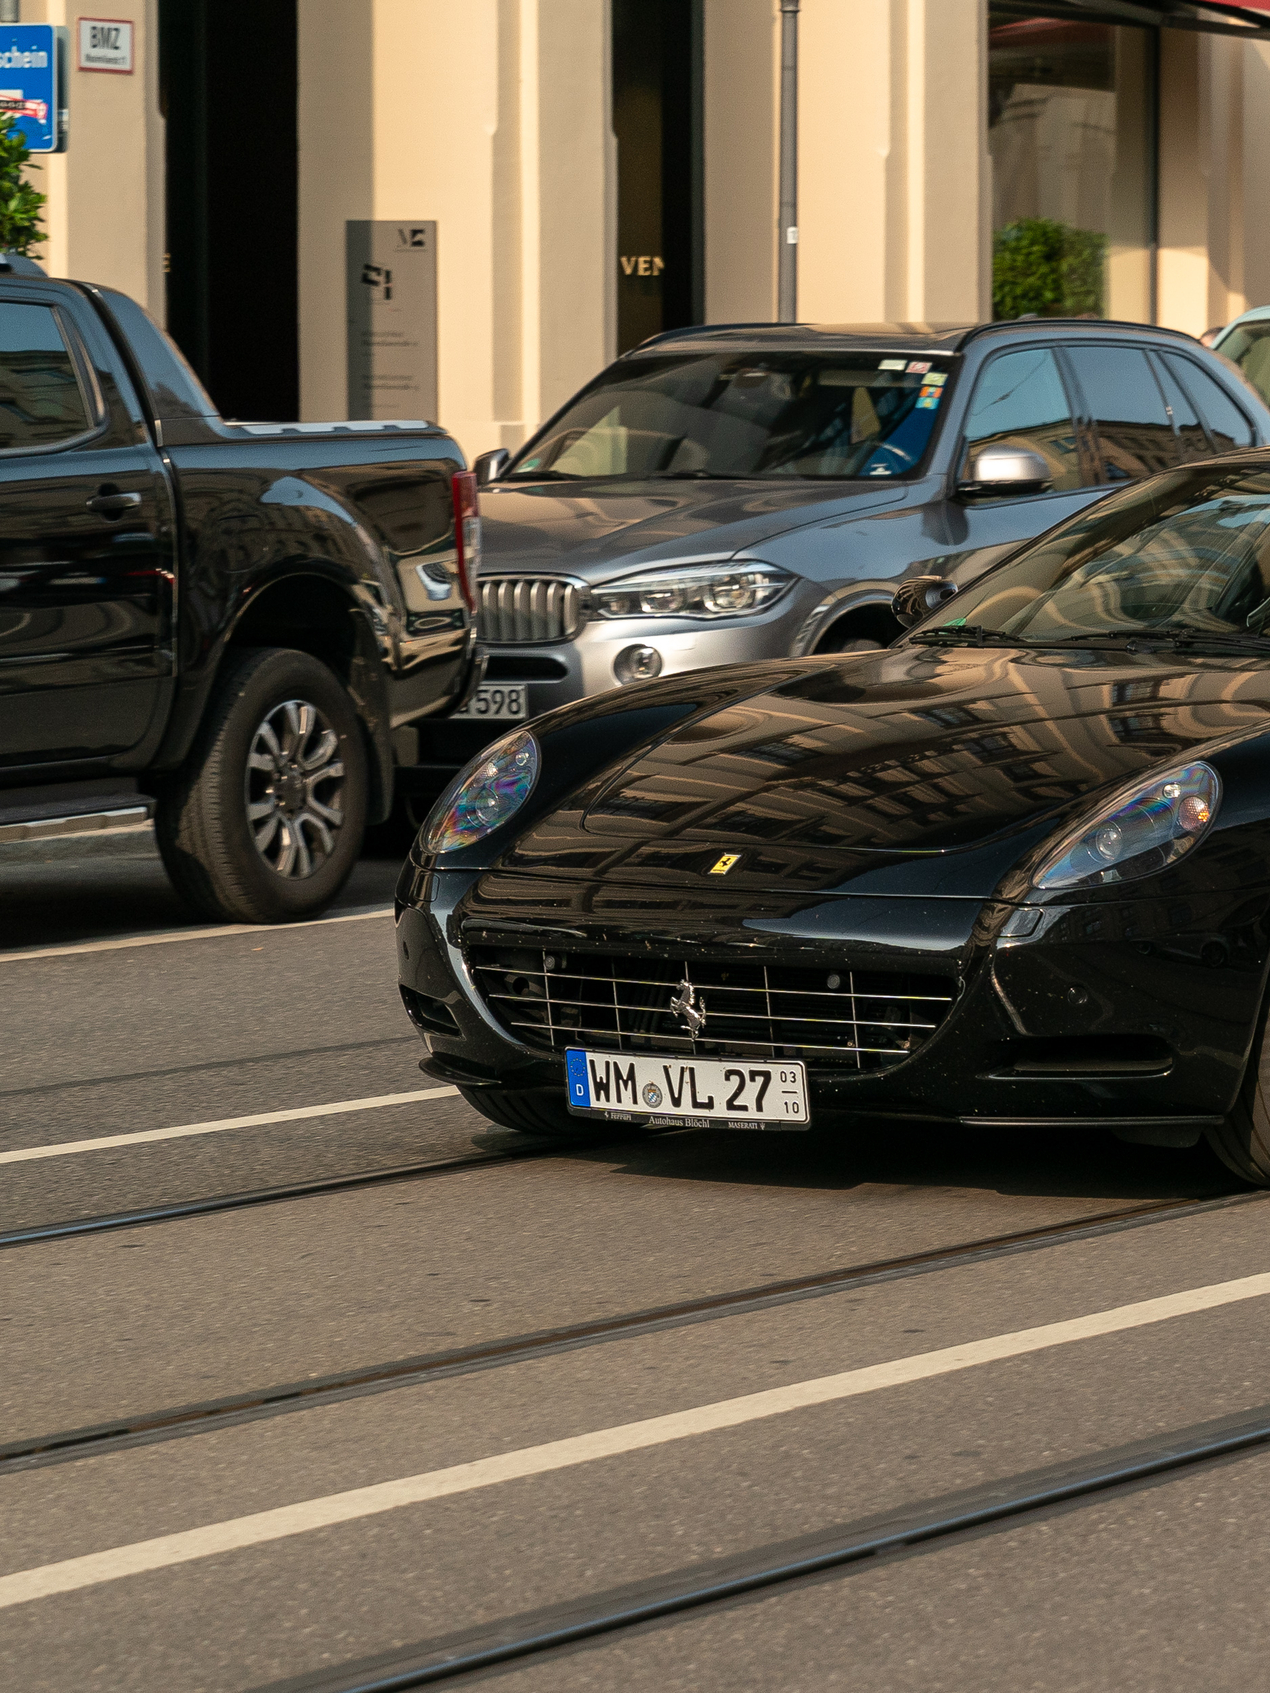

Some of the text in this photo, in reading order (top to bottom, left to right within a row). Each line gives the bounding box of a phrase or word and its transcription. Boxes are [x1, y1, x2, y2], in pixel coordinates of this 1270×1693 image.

[90, 26, 120, 50] BMZ
[780, 1070, 797, 1084] 03
[575, 1083, 584, 1096] D
[589, 1059, 772, 1113] WM VL 27
[783, 1101, 799, 1114] 10
[648, 1116, 684, 1126] Autohaus
